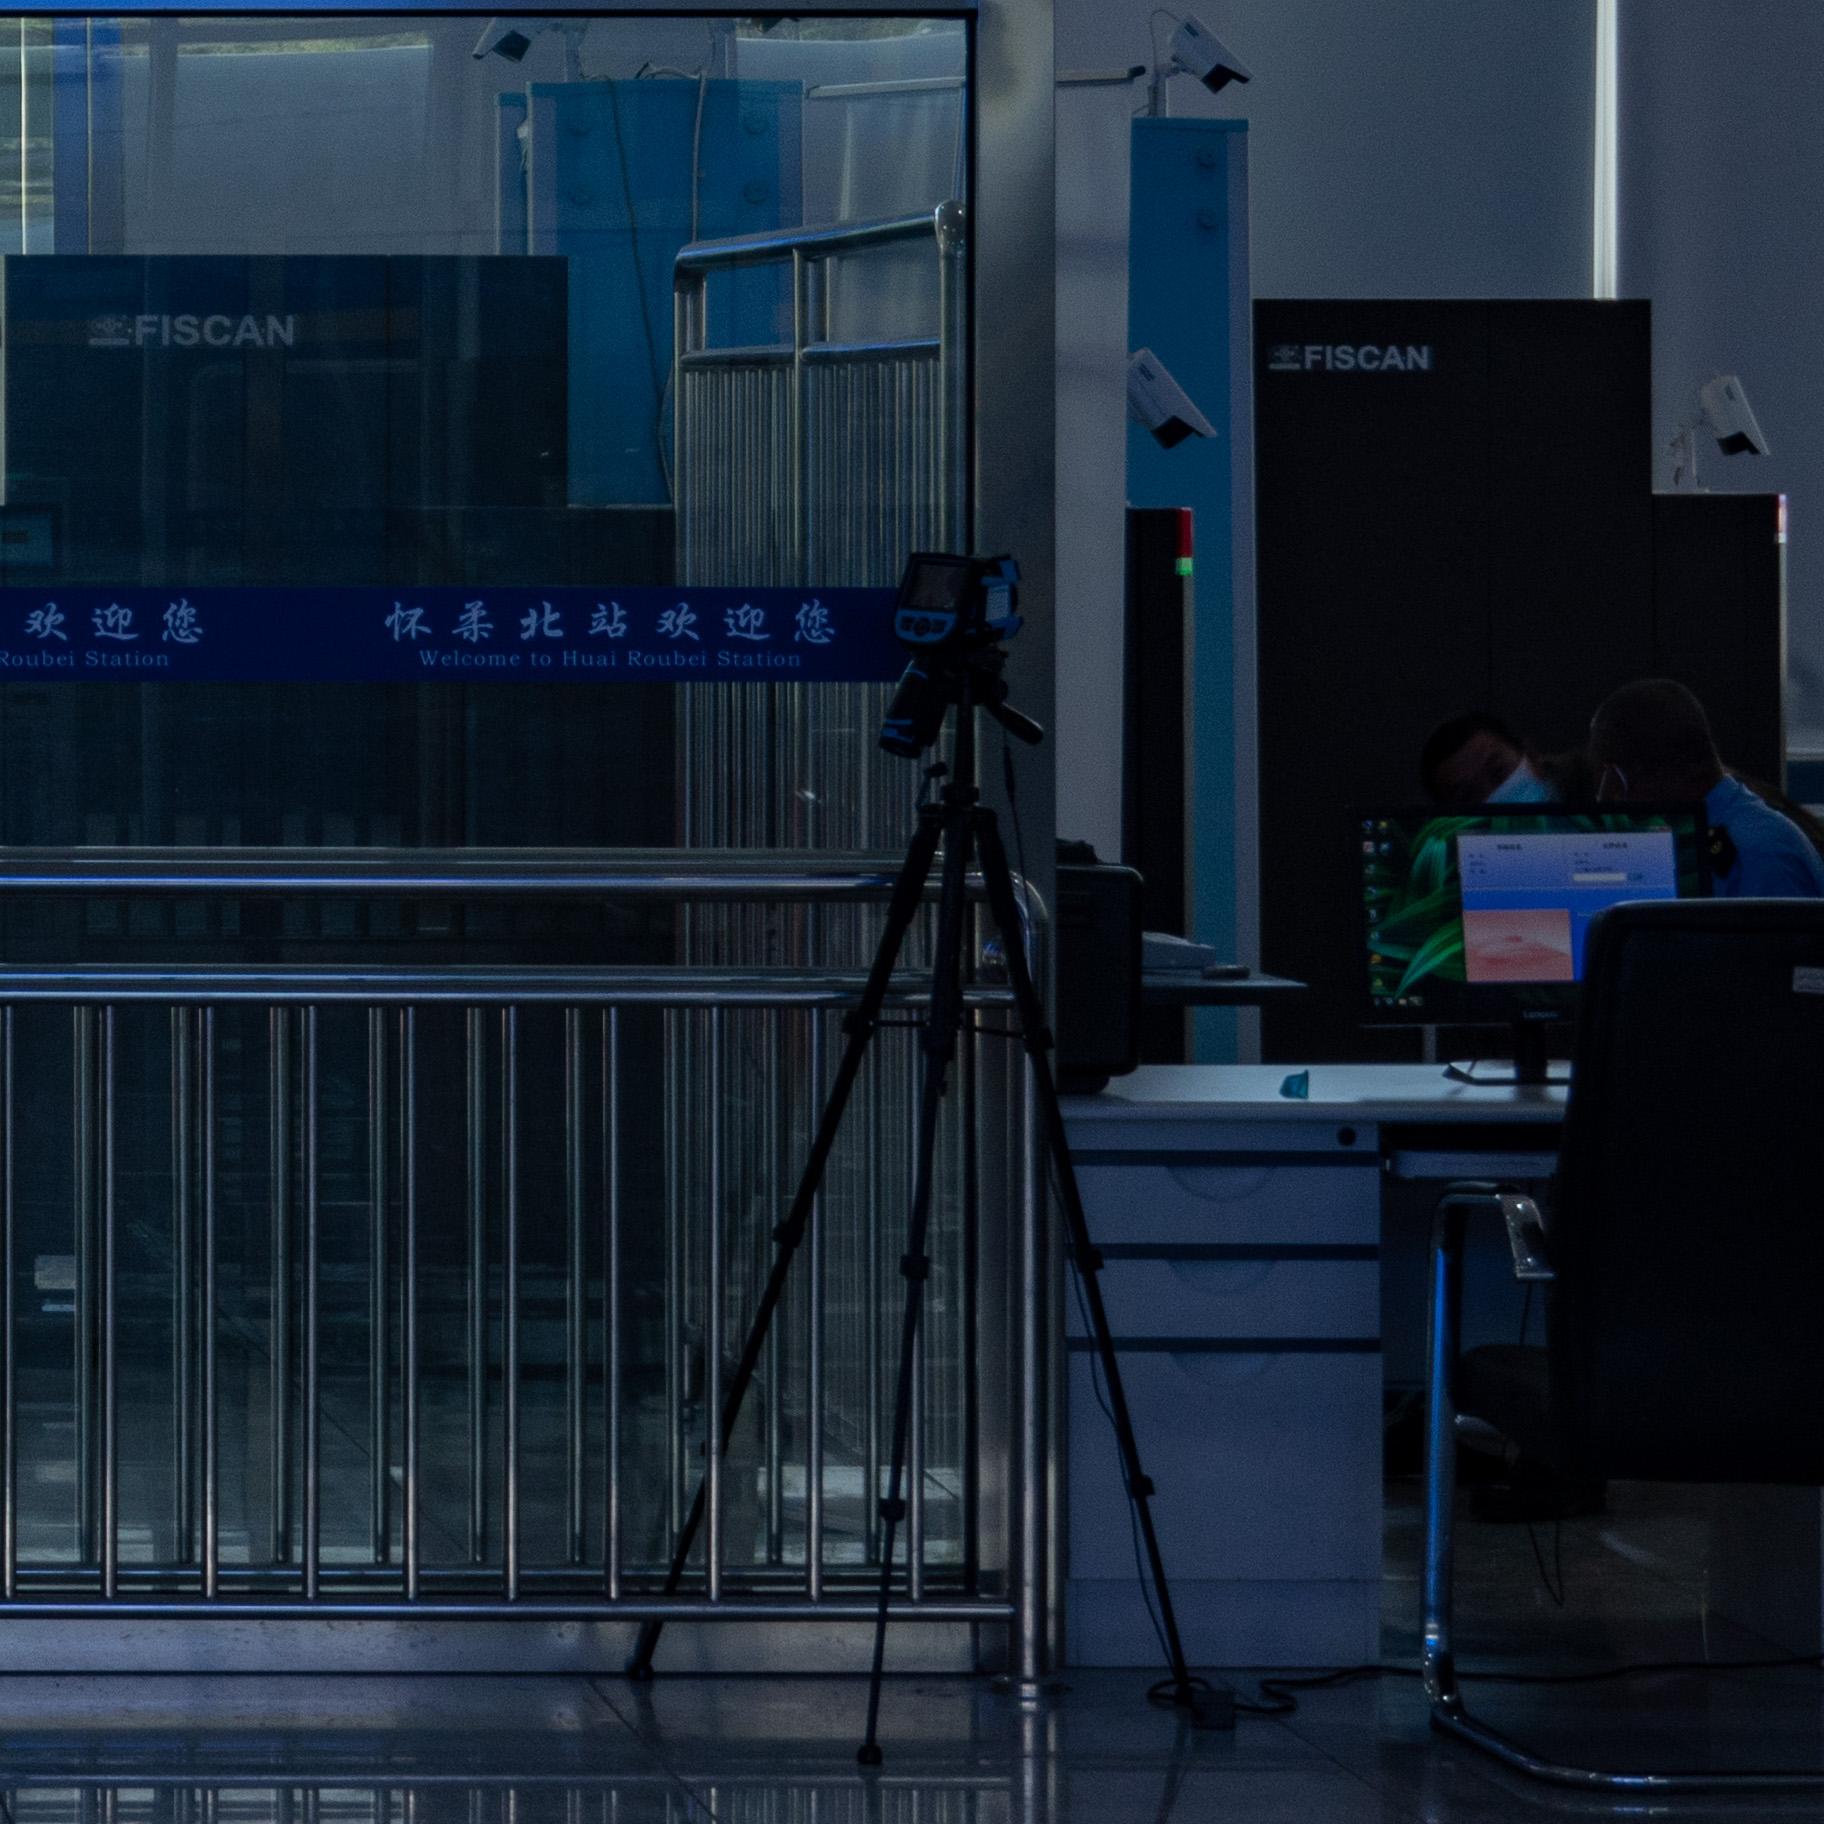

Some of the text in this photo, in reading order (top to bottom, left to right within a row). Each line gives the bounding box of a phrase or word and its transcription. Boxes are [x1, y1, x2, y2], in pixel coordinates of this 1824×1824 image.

[134, 313, 295, 346] FISCAN
[1303, 344, 1432, 371] FISCAN
[384, 597, 836, 644] 怀柔北站欢迎您
[85, 649, 169, 667] Station
[418, 648, 801, 666] Welcome to Huai Roubei Station
